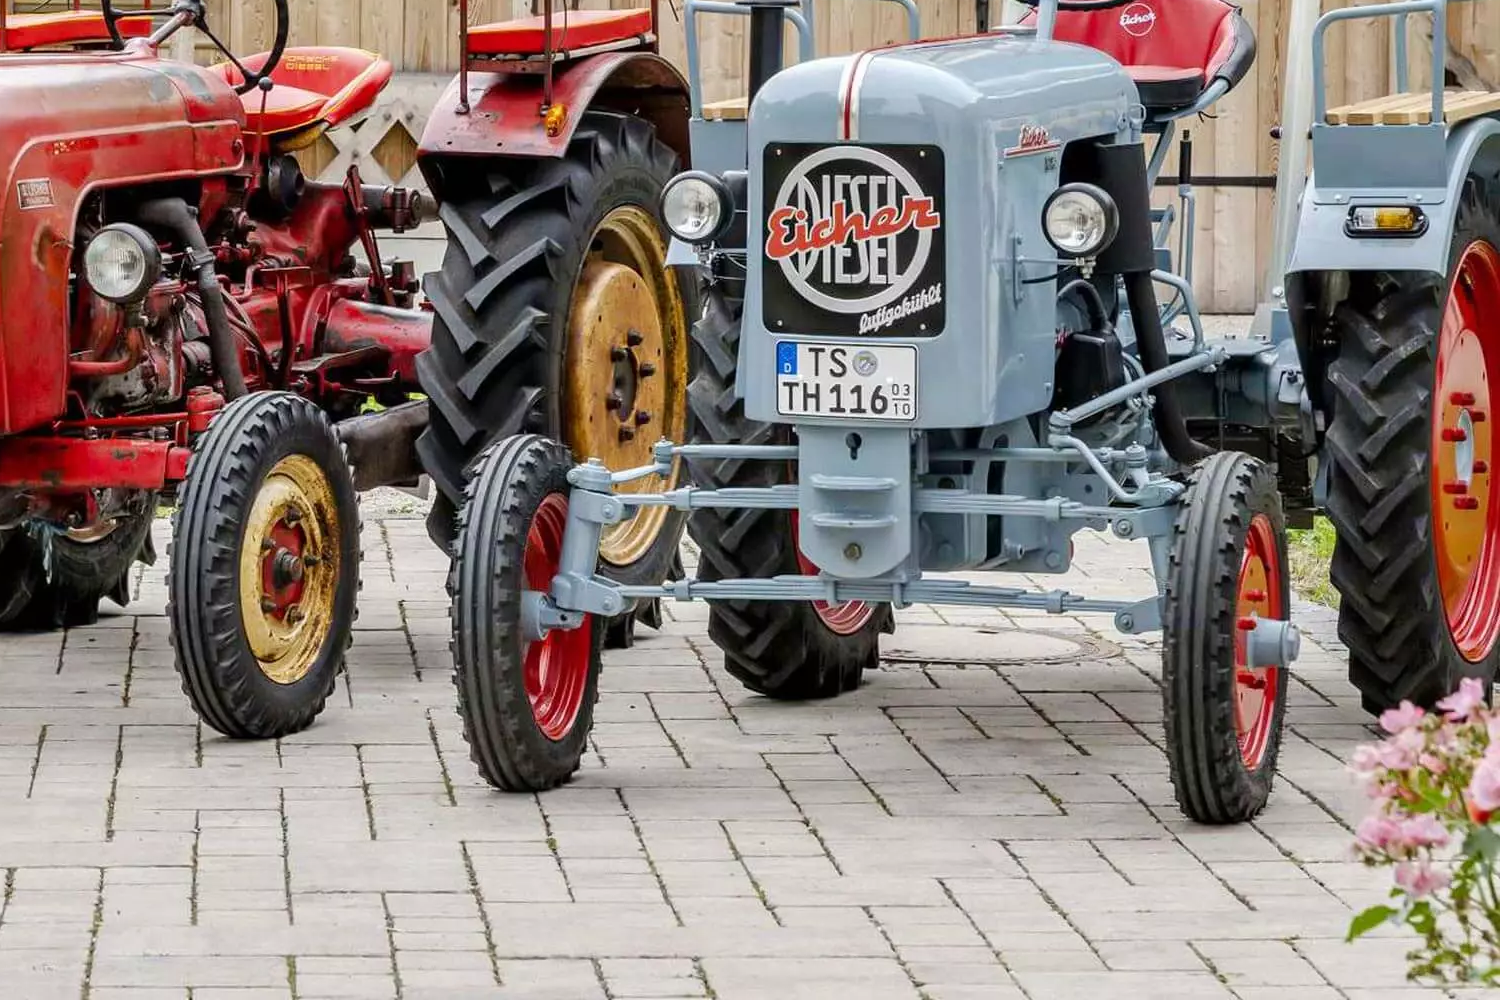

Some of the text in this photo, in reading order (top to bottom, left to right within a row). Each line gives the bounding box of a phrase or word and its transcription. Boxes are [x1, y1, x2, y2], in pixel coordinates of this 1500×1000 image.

[765, 195, 941, 261] Eicher
[797, 174, 905, 284] DIESEL
[784, 362, 792, 373] D
[808, 347, 847, 378] TS
[782, 381, 889, 415] TH 116
[891, 383, 910, 396] 03
[893, 403, 911, 416] 10
